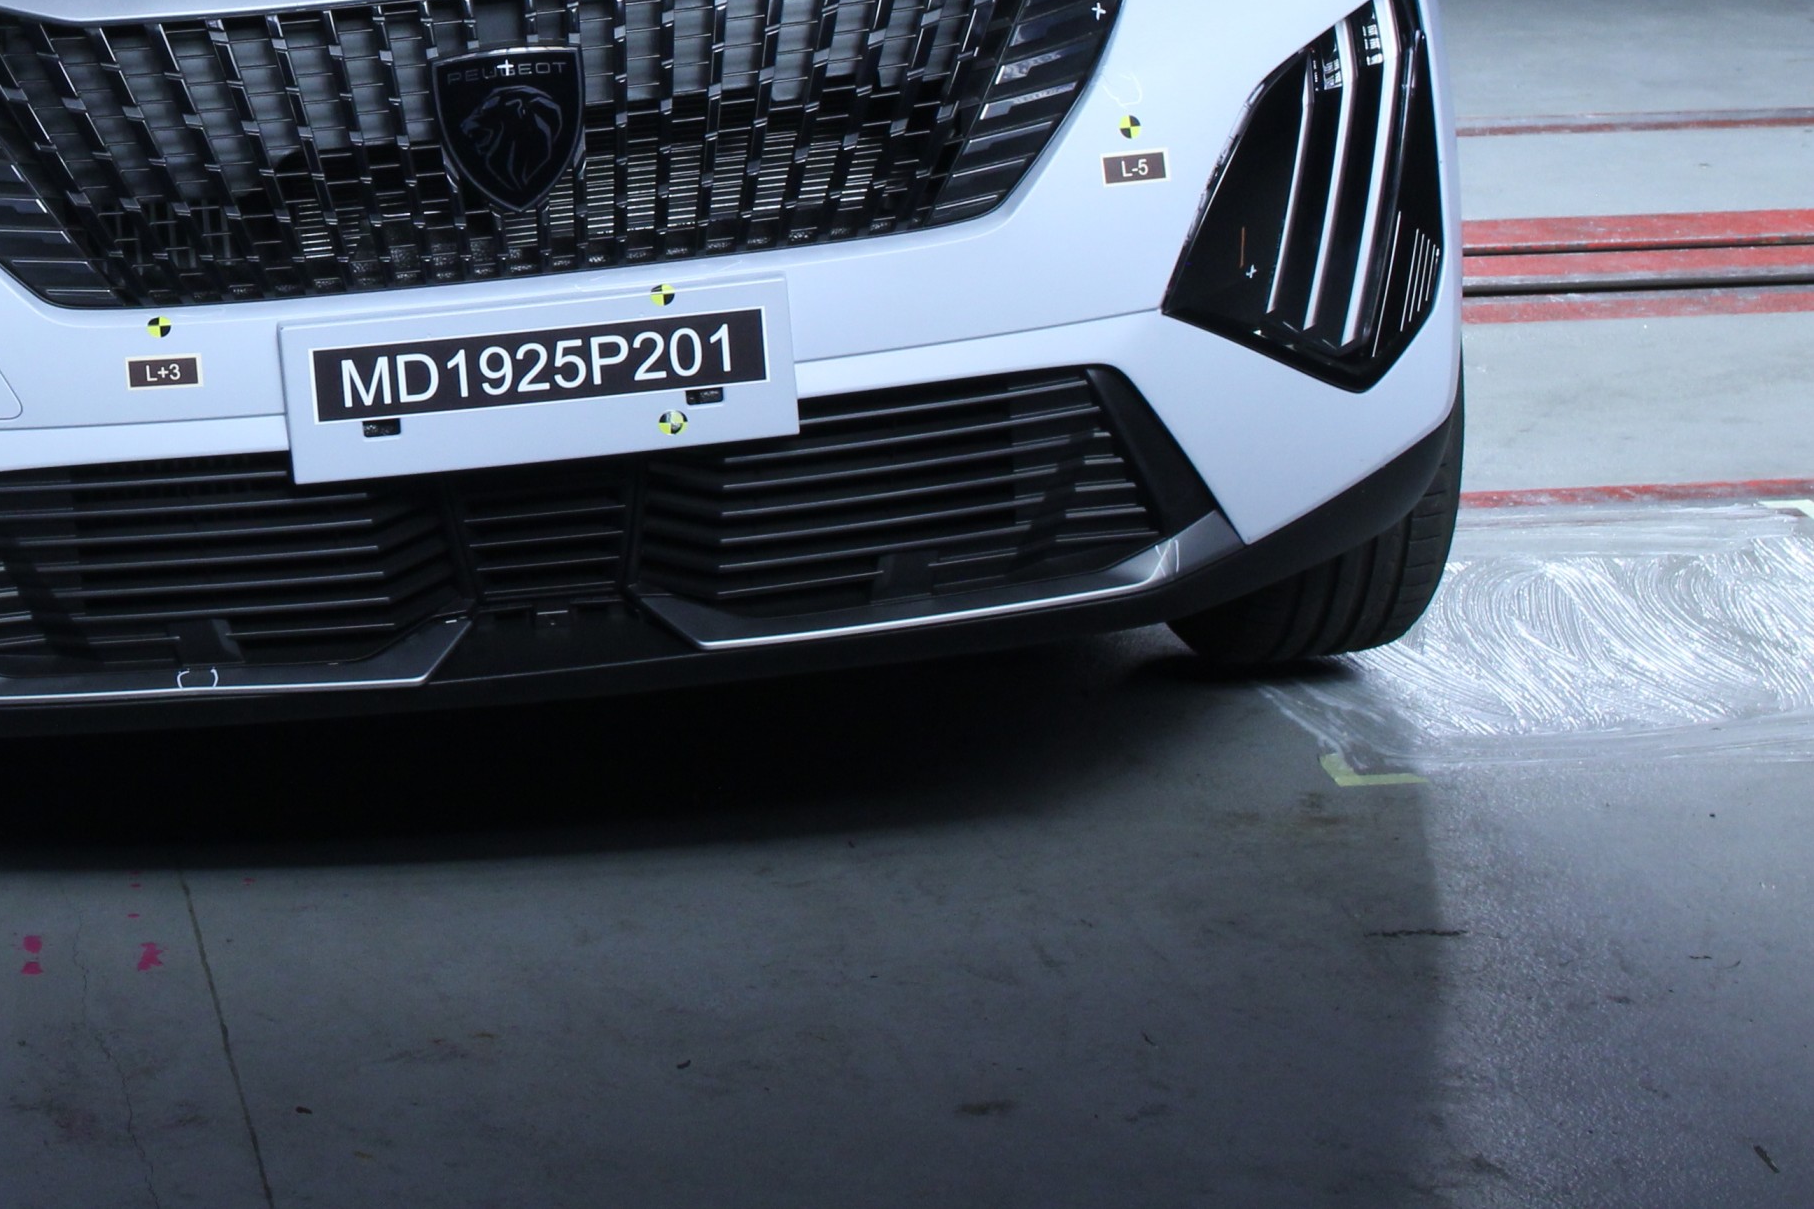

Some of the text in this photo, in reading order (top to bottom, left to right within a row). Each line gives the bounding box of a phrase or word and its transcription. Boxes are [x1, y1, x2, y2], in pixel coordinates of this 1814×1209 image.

[447, 61, 567, 85] PEUGEOT
[1121, 158, 1149, 178] L-5
[145, 361, 182, 383] L+3
[341, 323, 736, 409] MD1925P201
